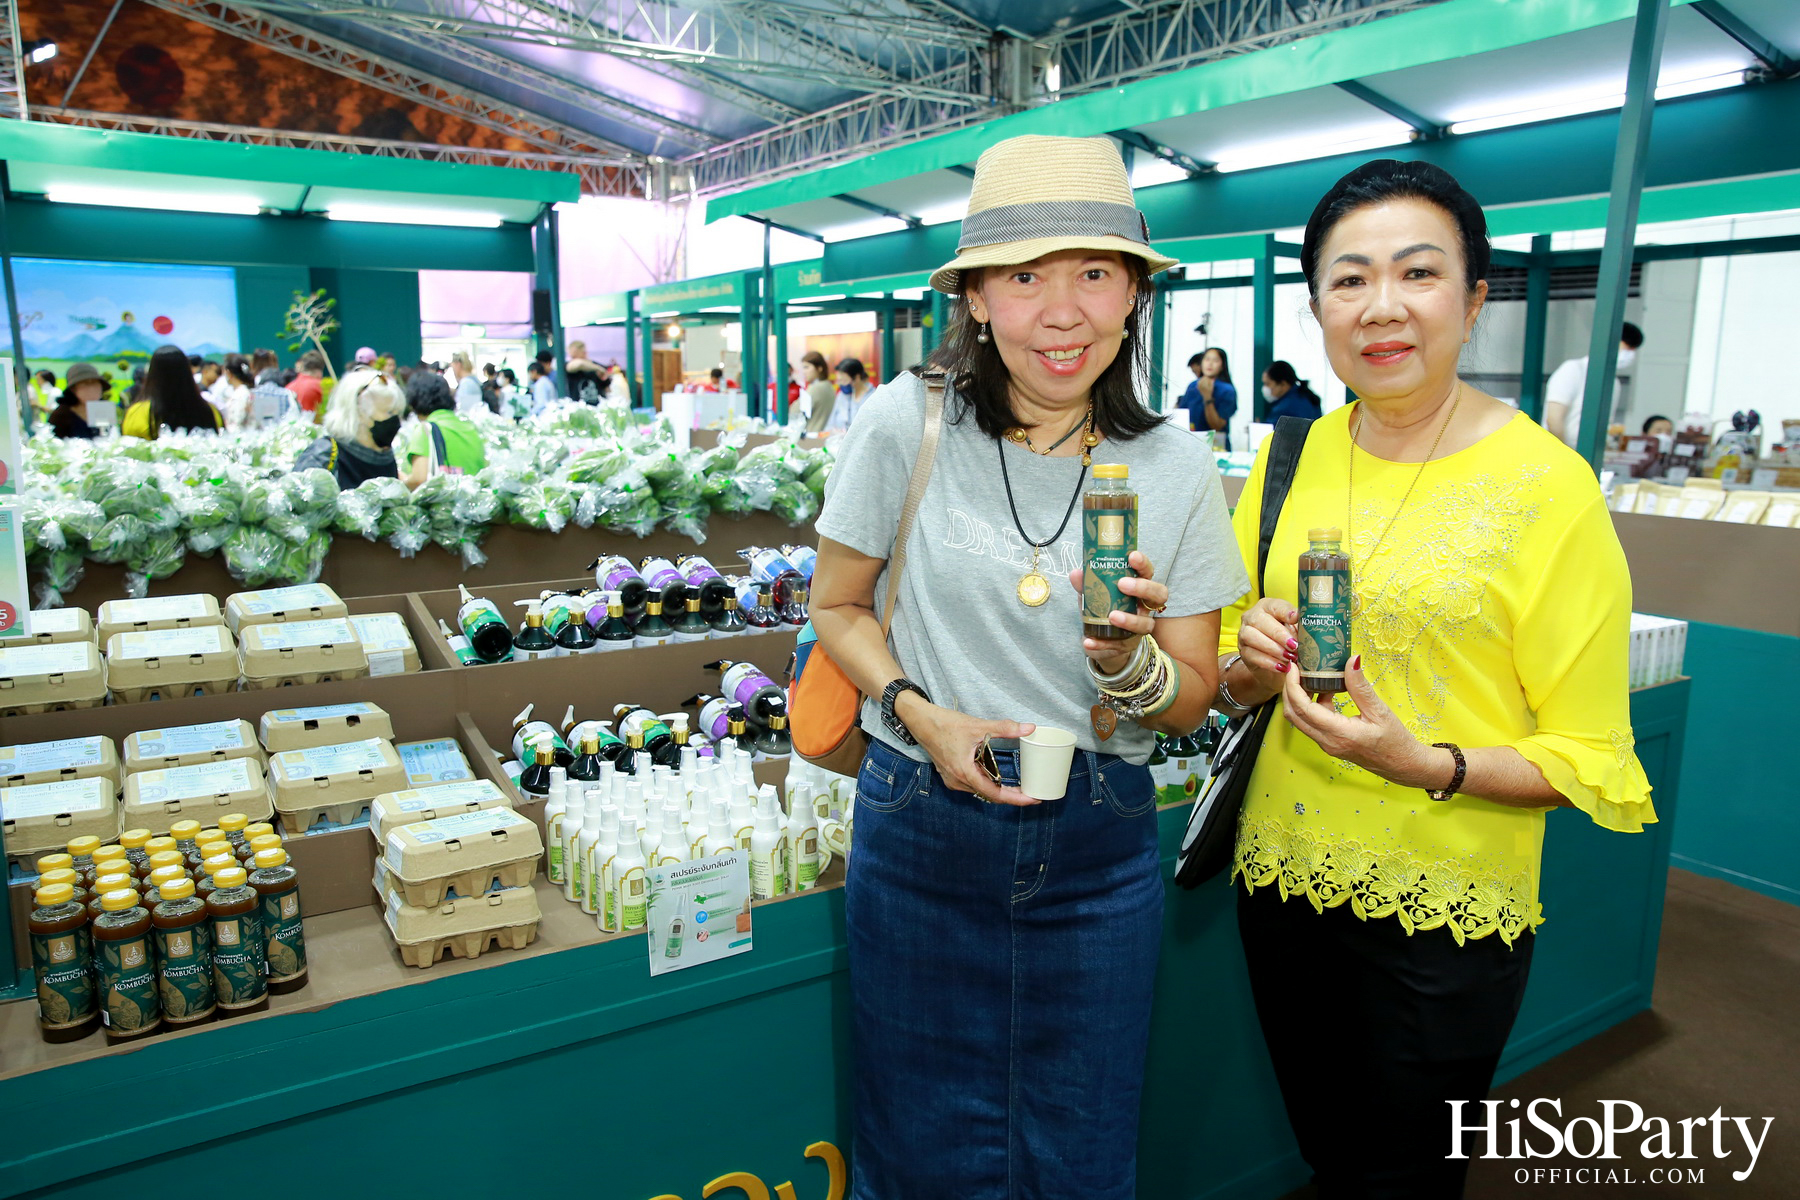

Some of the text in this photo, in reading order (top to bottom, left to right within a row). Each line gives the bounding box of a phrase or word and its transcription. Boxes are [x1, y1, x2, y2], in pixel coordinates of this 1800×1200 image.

[1301, 617, 1342, 626] KOMBUCHA
[51, 740, 83, 748] EGGS
[333, 744, 361, 754] EGGS
[48, 782, 81, 791] EGGS
[670, 857, 737, 879] สเปรย์ระงับกลิ่นเท้า
[213, 955, 252, 964] KOMBUCHA
[43, 969, 88, 985] KOMBUCHA
[163, 966, 204, 978] KOMBUCHA
[114, 975, 155, 992] KOMBUCHA
